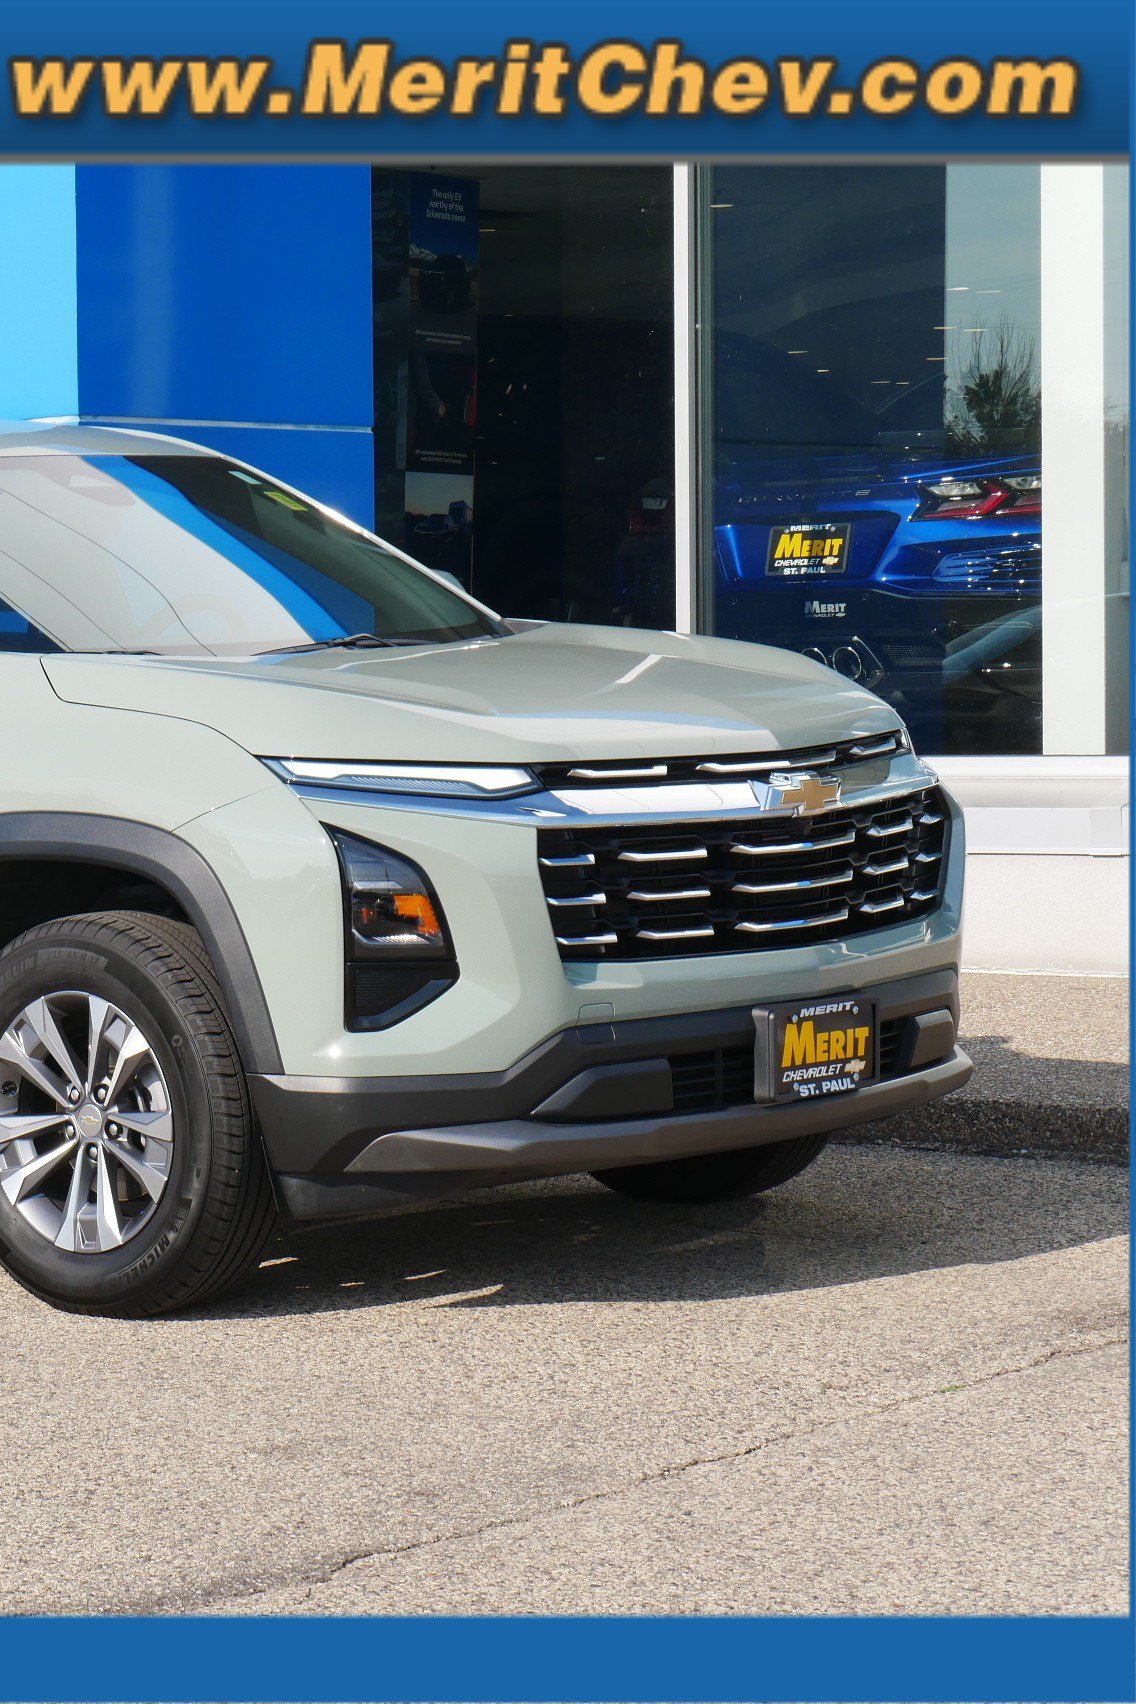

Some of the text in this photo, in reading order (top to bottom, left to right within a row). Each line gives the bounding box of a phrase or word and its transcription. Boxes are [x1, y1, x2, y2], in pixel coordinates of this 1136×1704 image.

[432, 188, 443, 199] The
[429, 199, 449, 212] worthy
[790, 523, 832, 532] MERIT
[774, 533, 844, 558] MERIT
[774, 558, 821, 567] CHEVROLET
[783, 566, 826, 576] ST. PAUL
[804, 600, 847, 613] MERIT
[799, 1000, 855, 1018] MERIT
[781, 1021, 870, 1068] MERIT
[782, 1063, 843, 1083] CHEVROLET
[799, 1077, 856, 1097] ST. PAUL
